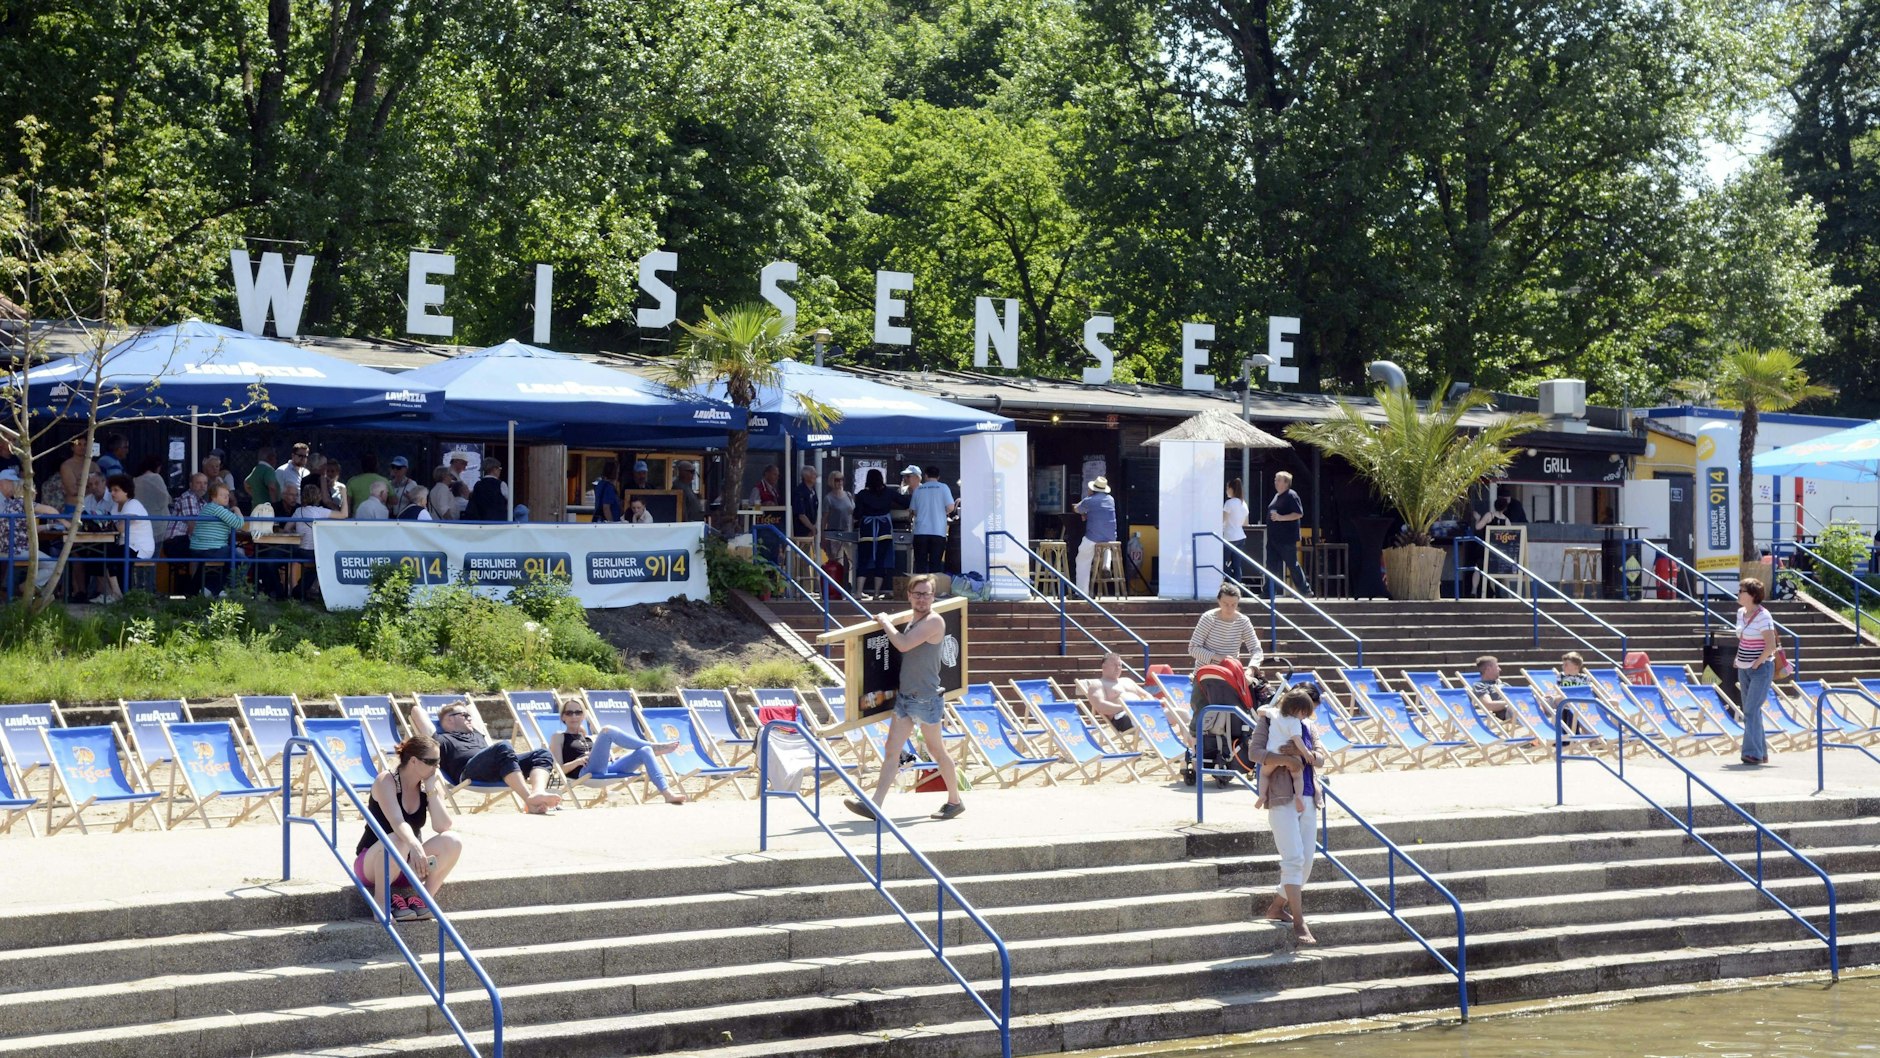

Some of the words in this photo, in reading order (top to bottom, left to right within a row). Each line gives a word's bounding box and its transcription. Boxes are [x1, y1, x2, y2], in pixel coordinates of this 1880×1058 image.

[230, 249, 1301, 391] WEISSENSEE
[385, 389, 428, 403] LAVAZZA
[693, 408, 732, 420] LAVAZZA
[1543, 457, 1572, 473] GRILL
[1711, 509, 1719, 546] BERLINER
[1719, 505, 1727, 546] RUNDFUNK
[1494, 531, 1517, 543] Tiger
[341, 556, 391, 568] BERLINER
[470, 558, 517, 569] BERLINER
[592, 557, 637, 568] BERLINER
[343, 568, 374, 579] RUND
[469, 569, 523, 580] RUNDFUNK
[592, 567, 645, 579] RUNDFUNK
[517, 700, 552, 711] LAVAZZA
[594, 698, 630, 709] LAVAZZA
[689, 697, 724, 708] LAVAZZA
[763, 696, 795, 707] LAVAZZA
[135, 710, 179, 723] LAVAZZA
[250, 705, 290, 717] LAVAZZA
[350, 705, 388, 716] LAVAZZA
[5, 714, 49, 727] LAVAZZA
[67, 765, 112, 783] Tiger
[187, 759, 231, 777] Tiger
